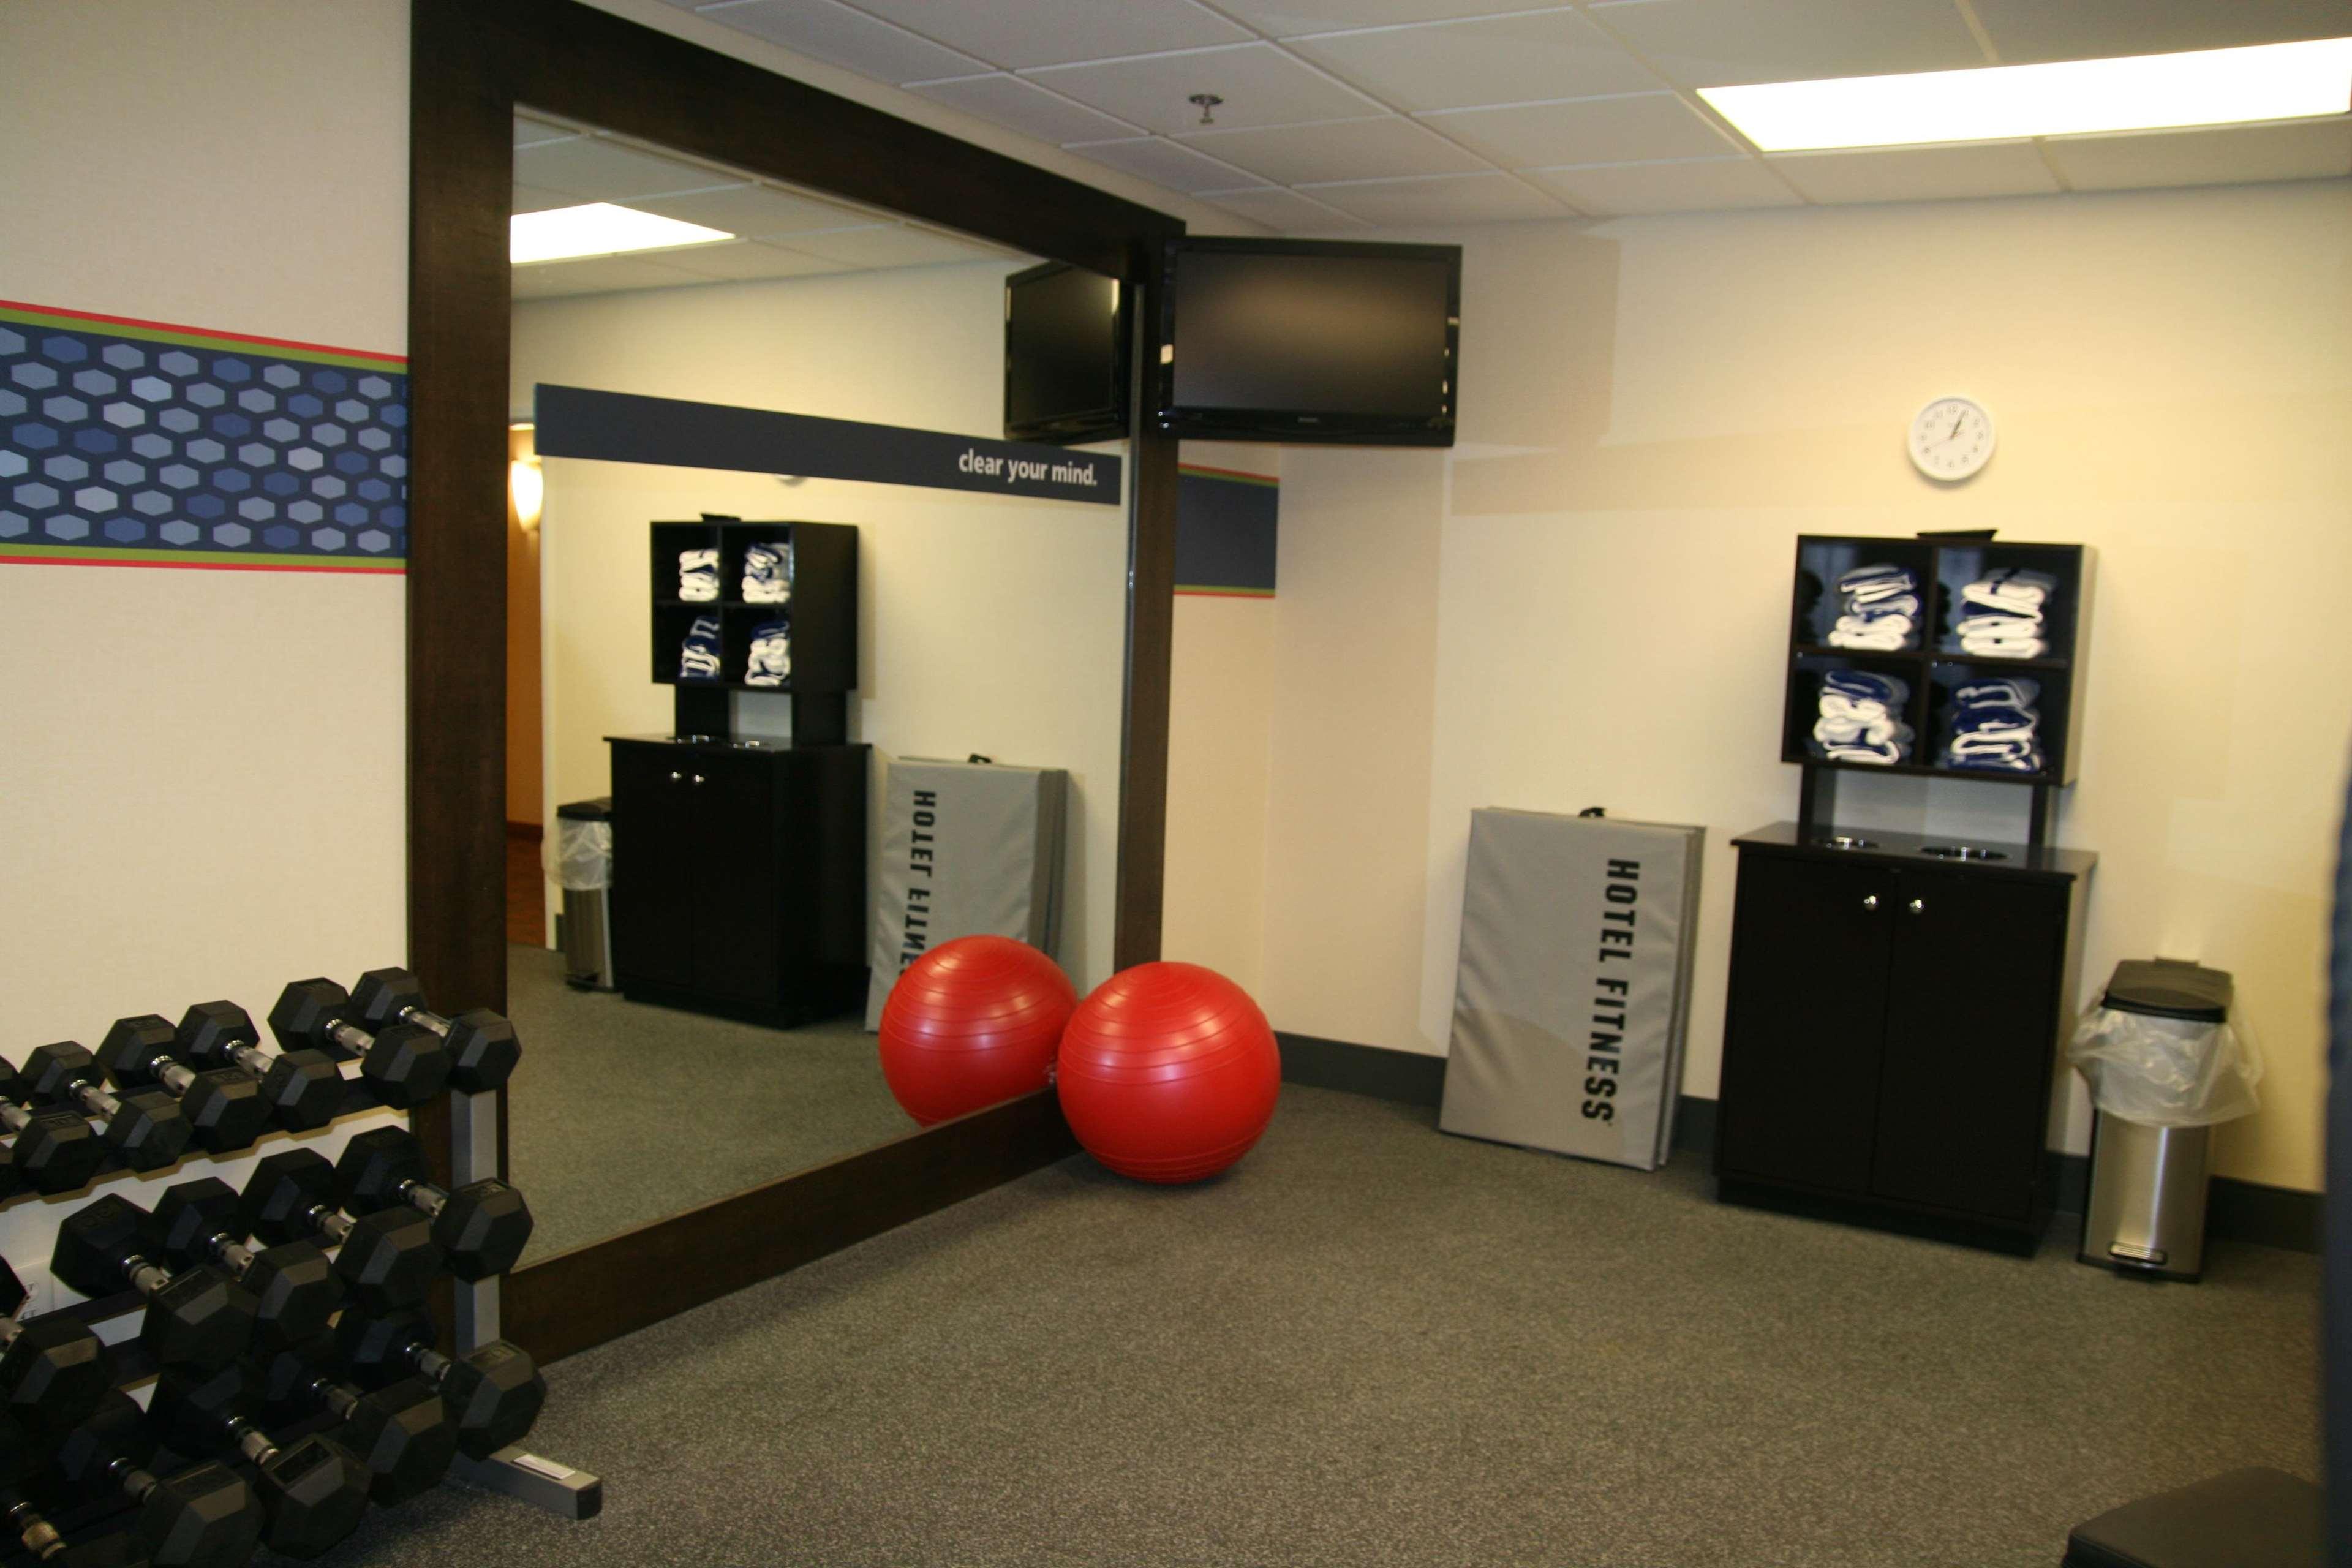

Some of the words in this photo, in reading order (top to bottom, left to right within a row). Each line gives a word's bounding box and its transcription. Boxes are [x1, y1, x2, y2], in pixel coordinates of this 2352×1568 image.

[958, 448, 1003, 475] clear
[1008, 459, 1047, 483] your
[1052, 461, 1098, 486] mind.
[1599, 859, 1640, 962] HOTEL
[1581, 978, 1629, 1122] FITNESS
